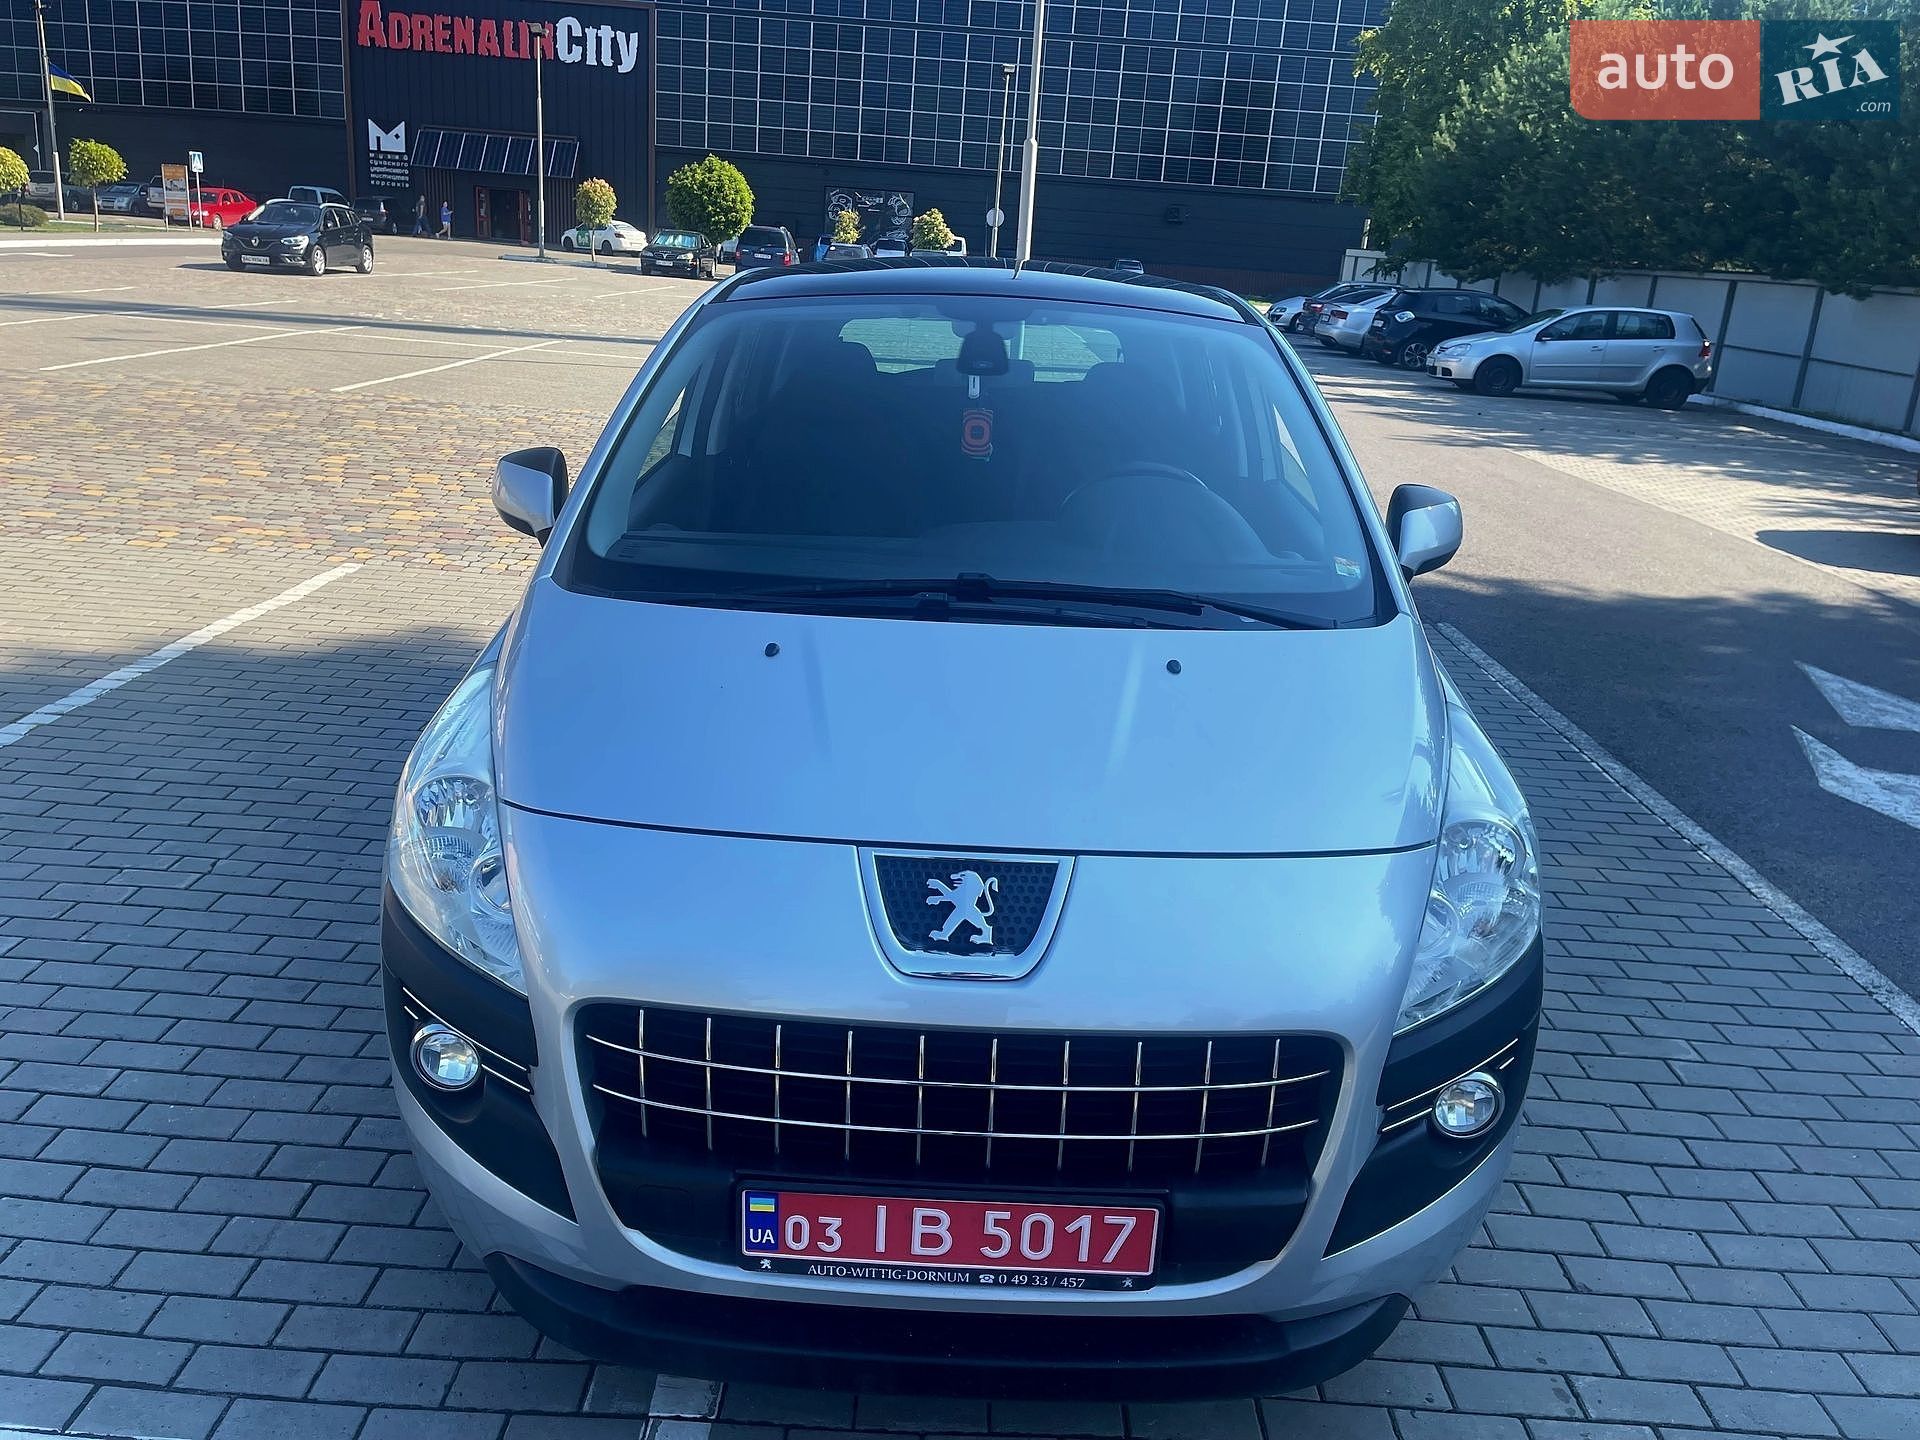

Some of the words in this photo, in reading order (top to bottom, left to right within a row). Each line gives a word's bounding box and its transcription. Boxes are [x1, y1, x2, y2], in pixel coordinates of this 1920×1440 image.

[749, 1229, 775, 1244] UA
[784, 1215, 843, 1253] 03
[979, 1210, 1137, 1263] 5017
[807, 1264, 970, 1283] AUTO-WITTIG-DORNUM
[1011, 1274, 1028, 1285] 49
[1031, 1275, 1048, 1286] 33
[1060, 1277, 1086, 1288] 457
